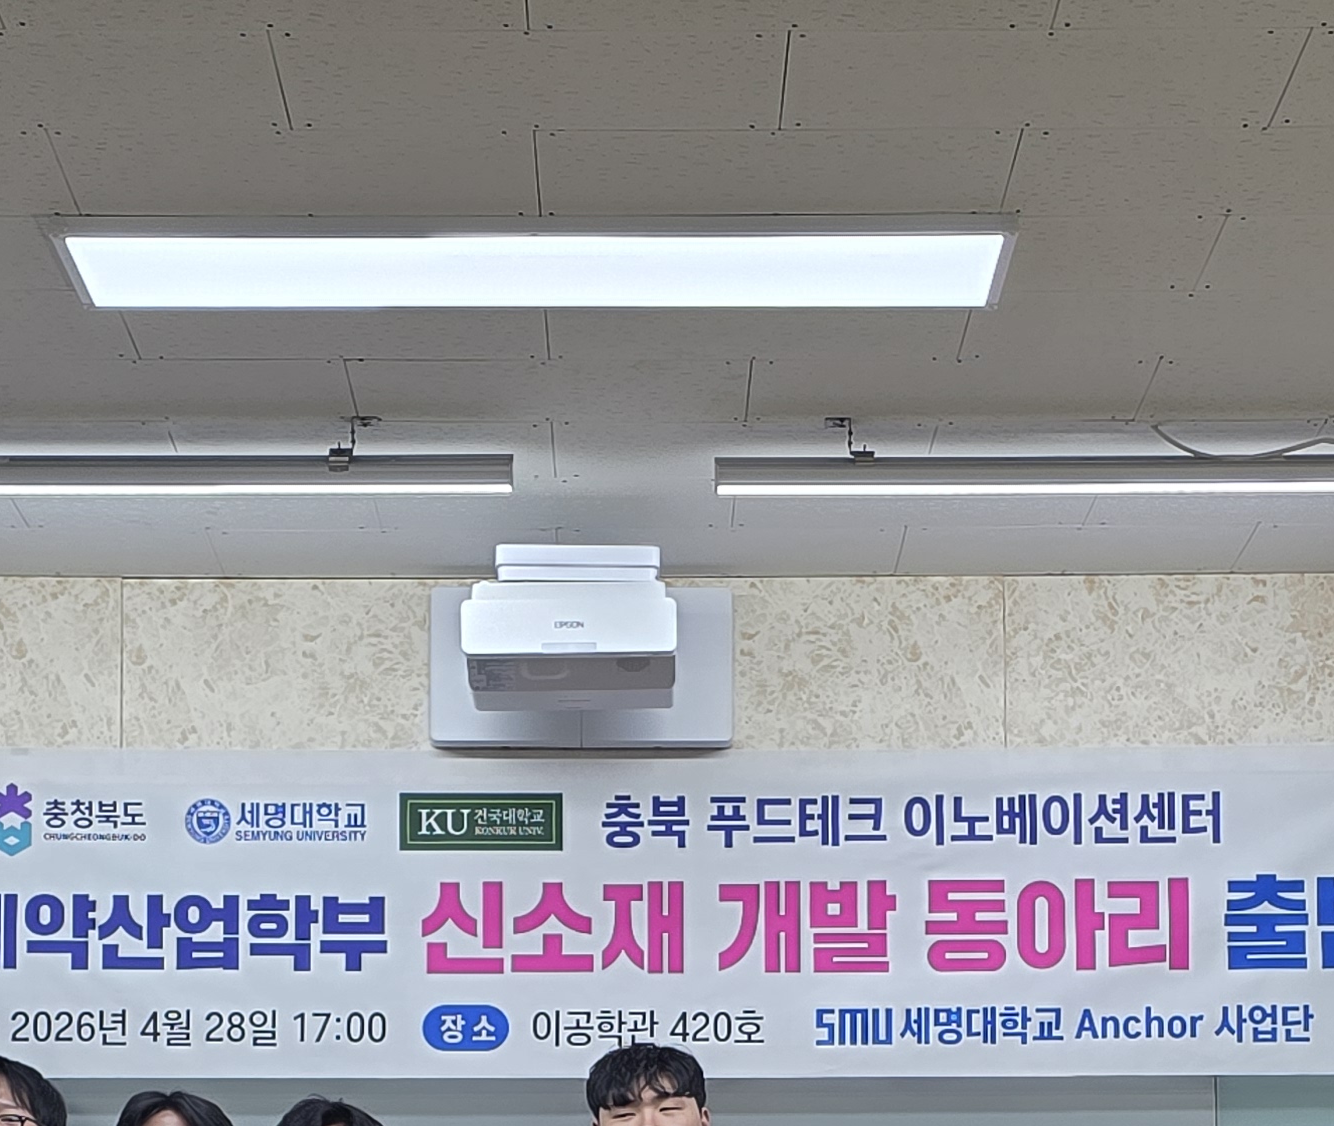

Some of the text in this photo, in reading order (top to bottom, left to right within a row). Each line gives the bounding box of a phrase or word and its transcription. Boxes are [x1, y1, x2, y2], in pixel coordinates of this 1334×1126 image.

[43, 799, 146, 828] 충청북도
[236, 803, 366, 828] 세명대학교
[418, 809, 471, 835] KU
[474, 808, 545, 824] 건국대학교
[602, 791, 1220, 848] 충북 푸드테크 이노베이션센터
[236, 830, 366, 841] SEMYUNG UNIVERSITY
[422, 881, 684, 974] 신소재
[719, 880, 896, 974] 개발
[925, 877, 1189, 972] 동아리
[11, 1009, 126, 1045] 2026년
[140, 1009, 191, 1046] 4월
[206, 1010, 277, 1046] 28일
[294, 1012, 386, 1042] 17:00
[533, 1010, 659, 1048] 이공학관
[670, 1010, 764, 1043] 420호
[900, 1006, 1063, 1044] 세명대학교
[1075, 1007, 1204, 1039] Anchor
[1215, 1005, 1314, 1043] 사업단
